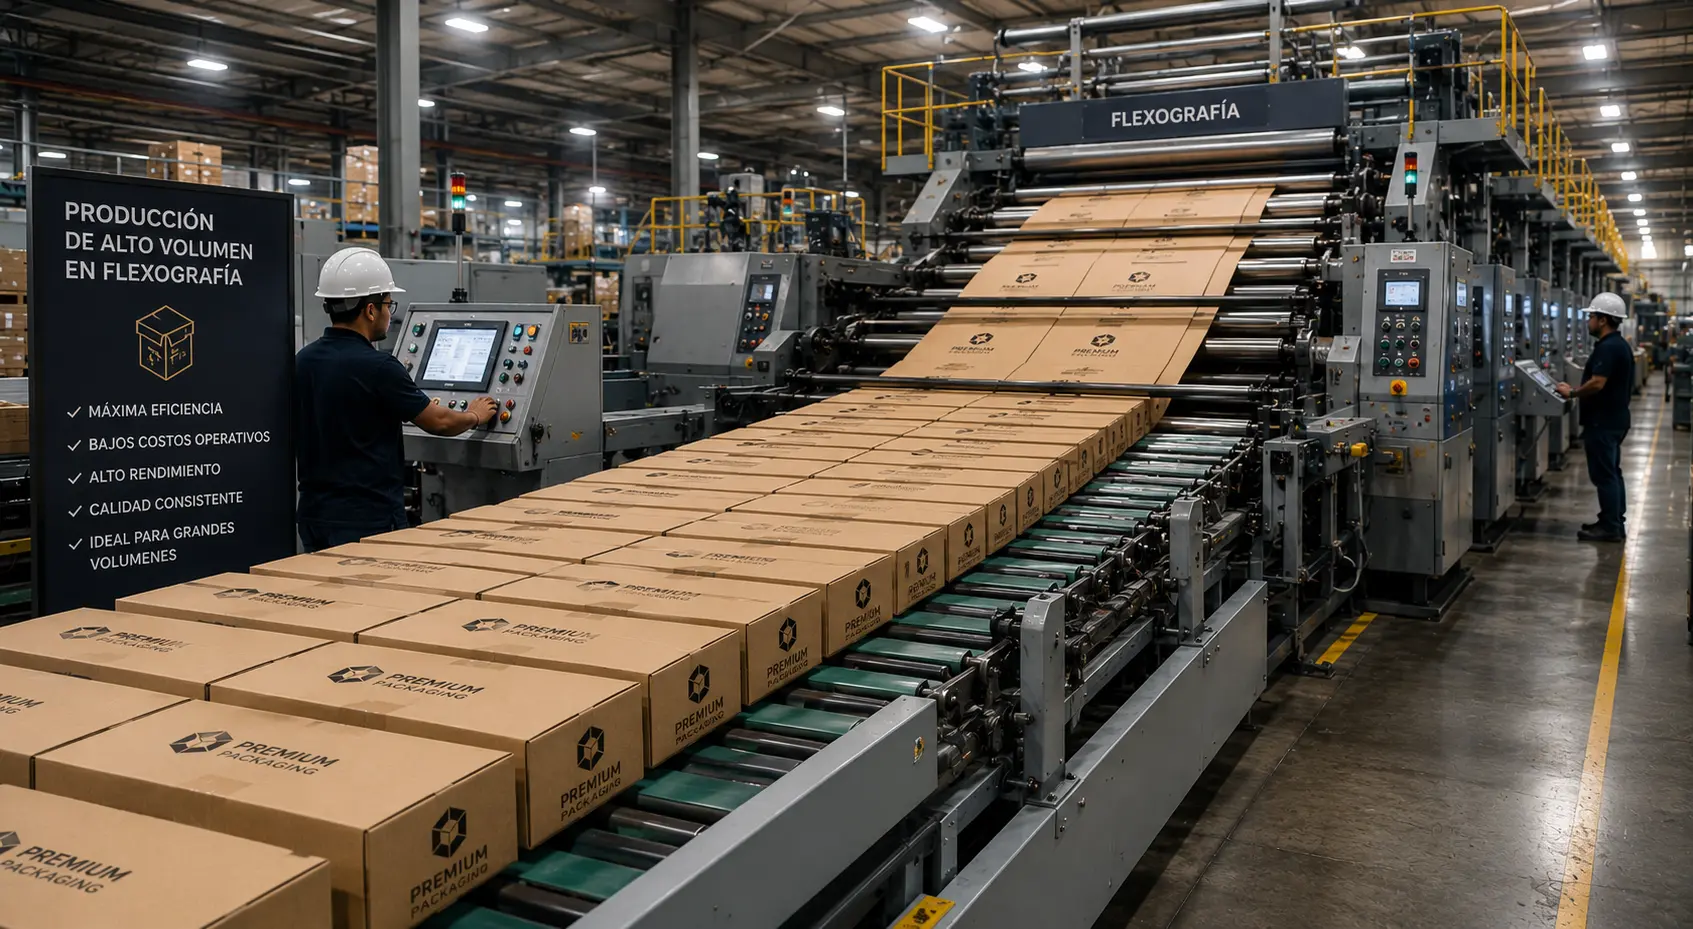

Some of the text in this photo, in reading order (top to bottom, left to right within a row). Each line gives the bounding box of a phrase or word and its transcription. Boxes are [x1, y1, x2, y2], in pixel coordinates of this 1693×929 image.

[1111, 99, 1241, 128] FLEXOGRAFÍA
[65, 201, 214, 232] PRODUCCIÓN
[65, 231, 253, 260] DE ALTO VOLUMEN
[65, 260, 243, 286] EN FLEXOGRAFÍA
[88, 401, 223, 418] MÁXIMA EFICIENCIA
[88, 430, 271, 451] BAJOS COSTOS OPERATIVOS
[89, 462, 221, 484] ALTO RENDIMIENTO
[89, 491, 243, 516] CALIDAD CONSISTENTE
[90, 520, 235, 549] IDEAL PARA GRANDES
[90, 547, 177, 570] VOLUMENES
[512, 623, 601, 640] PREMIUM
[766, 646, 808, 679] PREMIUM
[372, 680, 469, 700] PACKAGING
[385, 673, 485, 695] PREMIUM
[674, 695, 724, 735] PREMIUM
[216, 750, 319, 776] PACKAGING
[233, 741, 340, 768] PREMIUM
[560, 760, 621, 809] PREMIUM
[0, 859, 105, 893] PACKAGING
[16, 845, 133, 882] PREMIUM
[410, 844, 488, 904] PREMIUM
